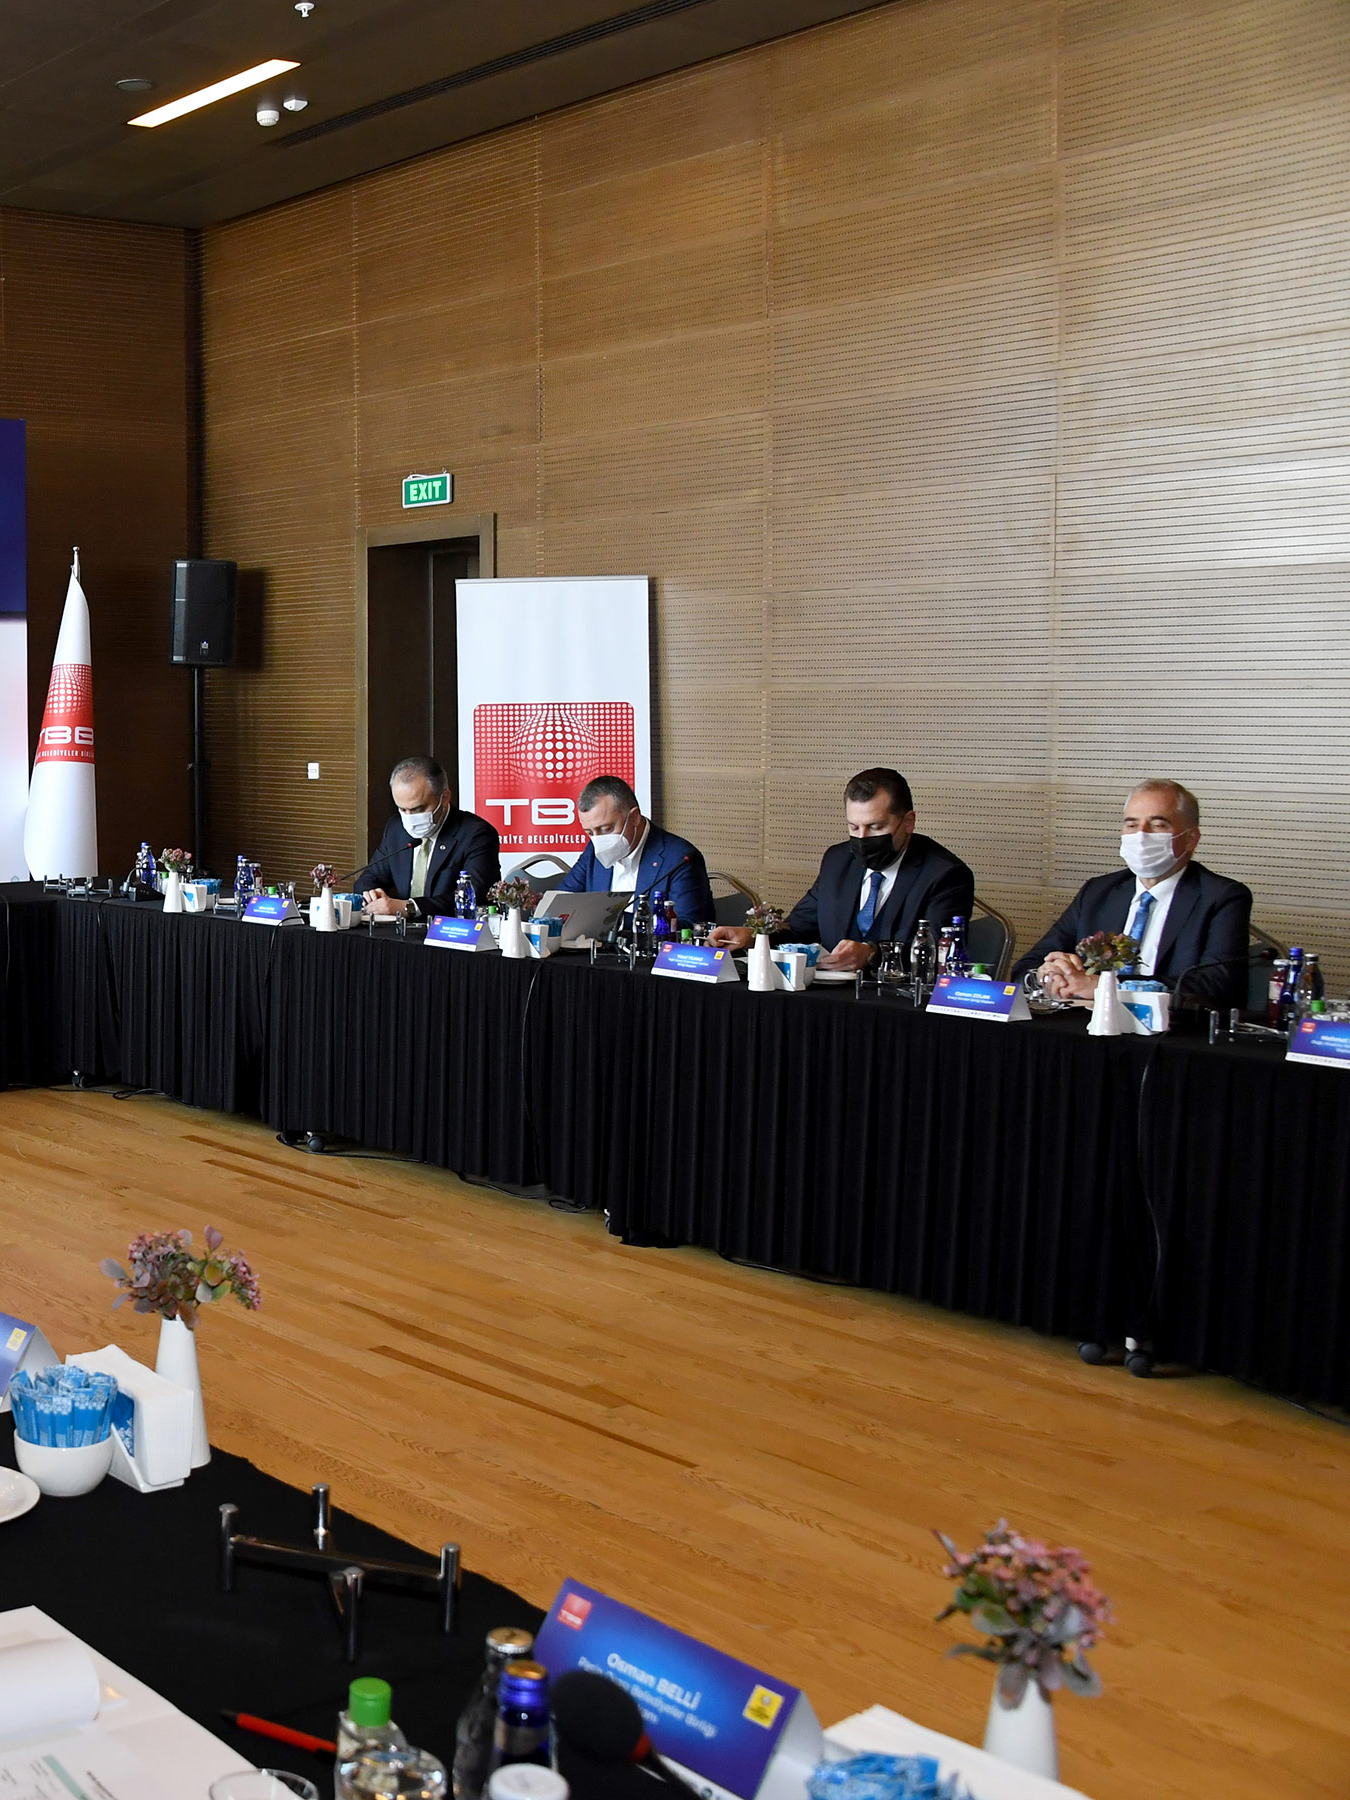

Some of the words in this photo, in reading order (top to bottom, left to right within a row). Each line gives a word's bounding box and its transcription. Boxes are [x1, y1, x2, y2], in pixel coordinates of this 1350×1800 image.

[410, 481, 442, 502] EXIT
[485, 798, 575, 826] TB
[499, 834, 523, 845] RKİYE
[527, 833, 586, 845] BELEDİYELER
[607, 1653, 656, 1688] Osman
[656, 1678, 702, 1711] BELLİ
[630, 1684, 686, 1720] Belediyeler
